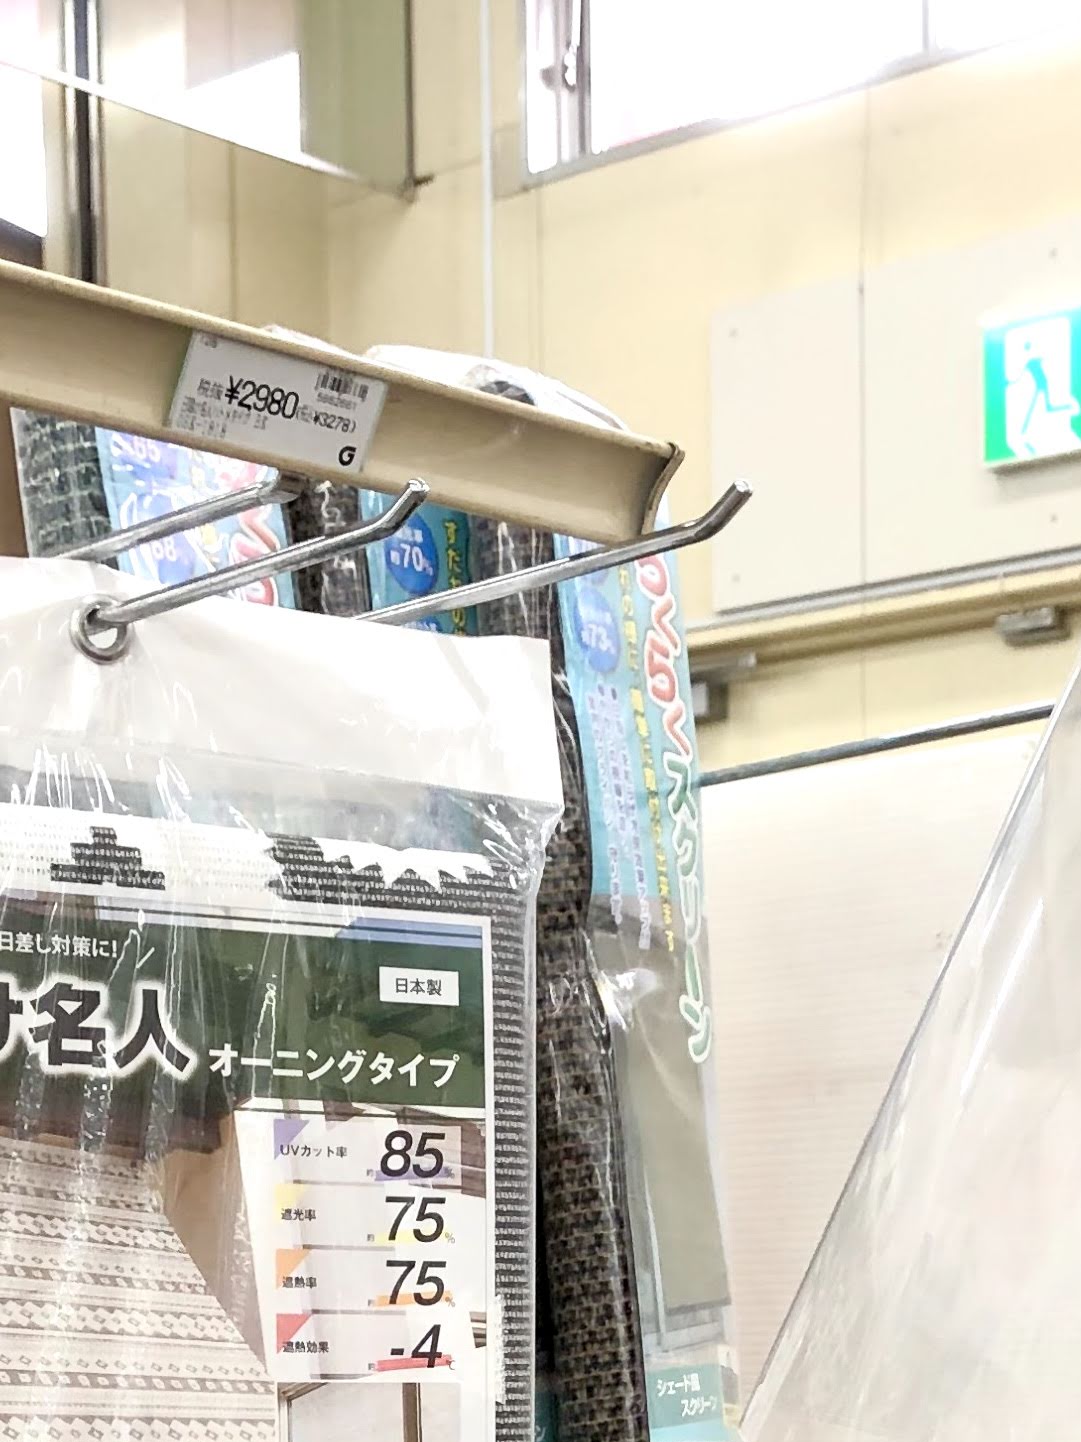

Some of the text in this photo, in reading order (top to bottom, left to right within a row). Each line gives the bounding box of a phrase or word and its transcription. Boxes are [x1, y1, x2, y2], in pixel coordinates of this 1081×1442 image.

[394, 977, 443, 997] 日本製
[208, 1042, 461, 1089] オーニングタイプ
[280, 1144, 348, 1158] UVカット率
